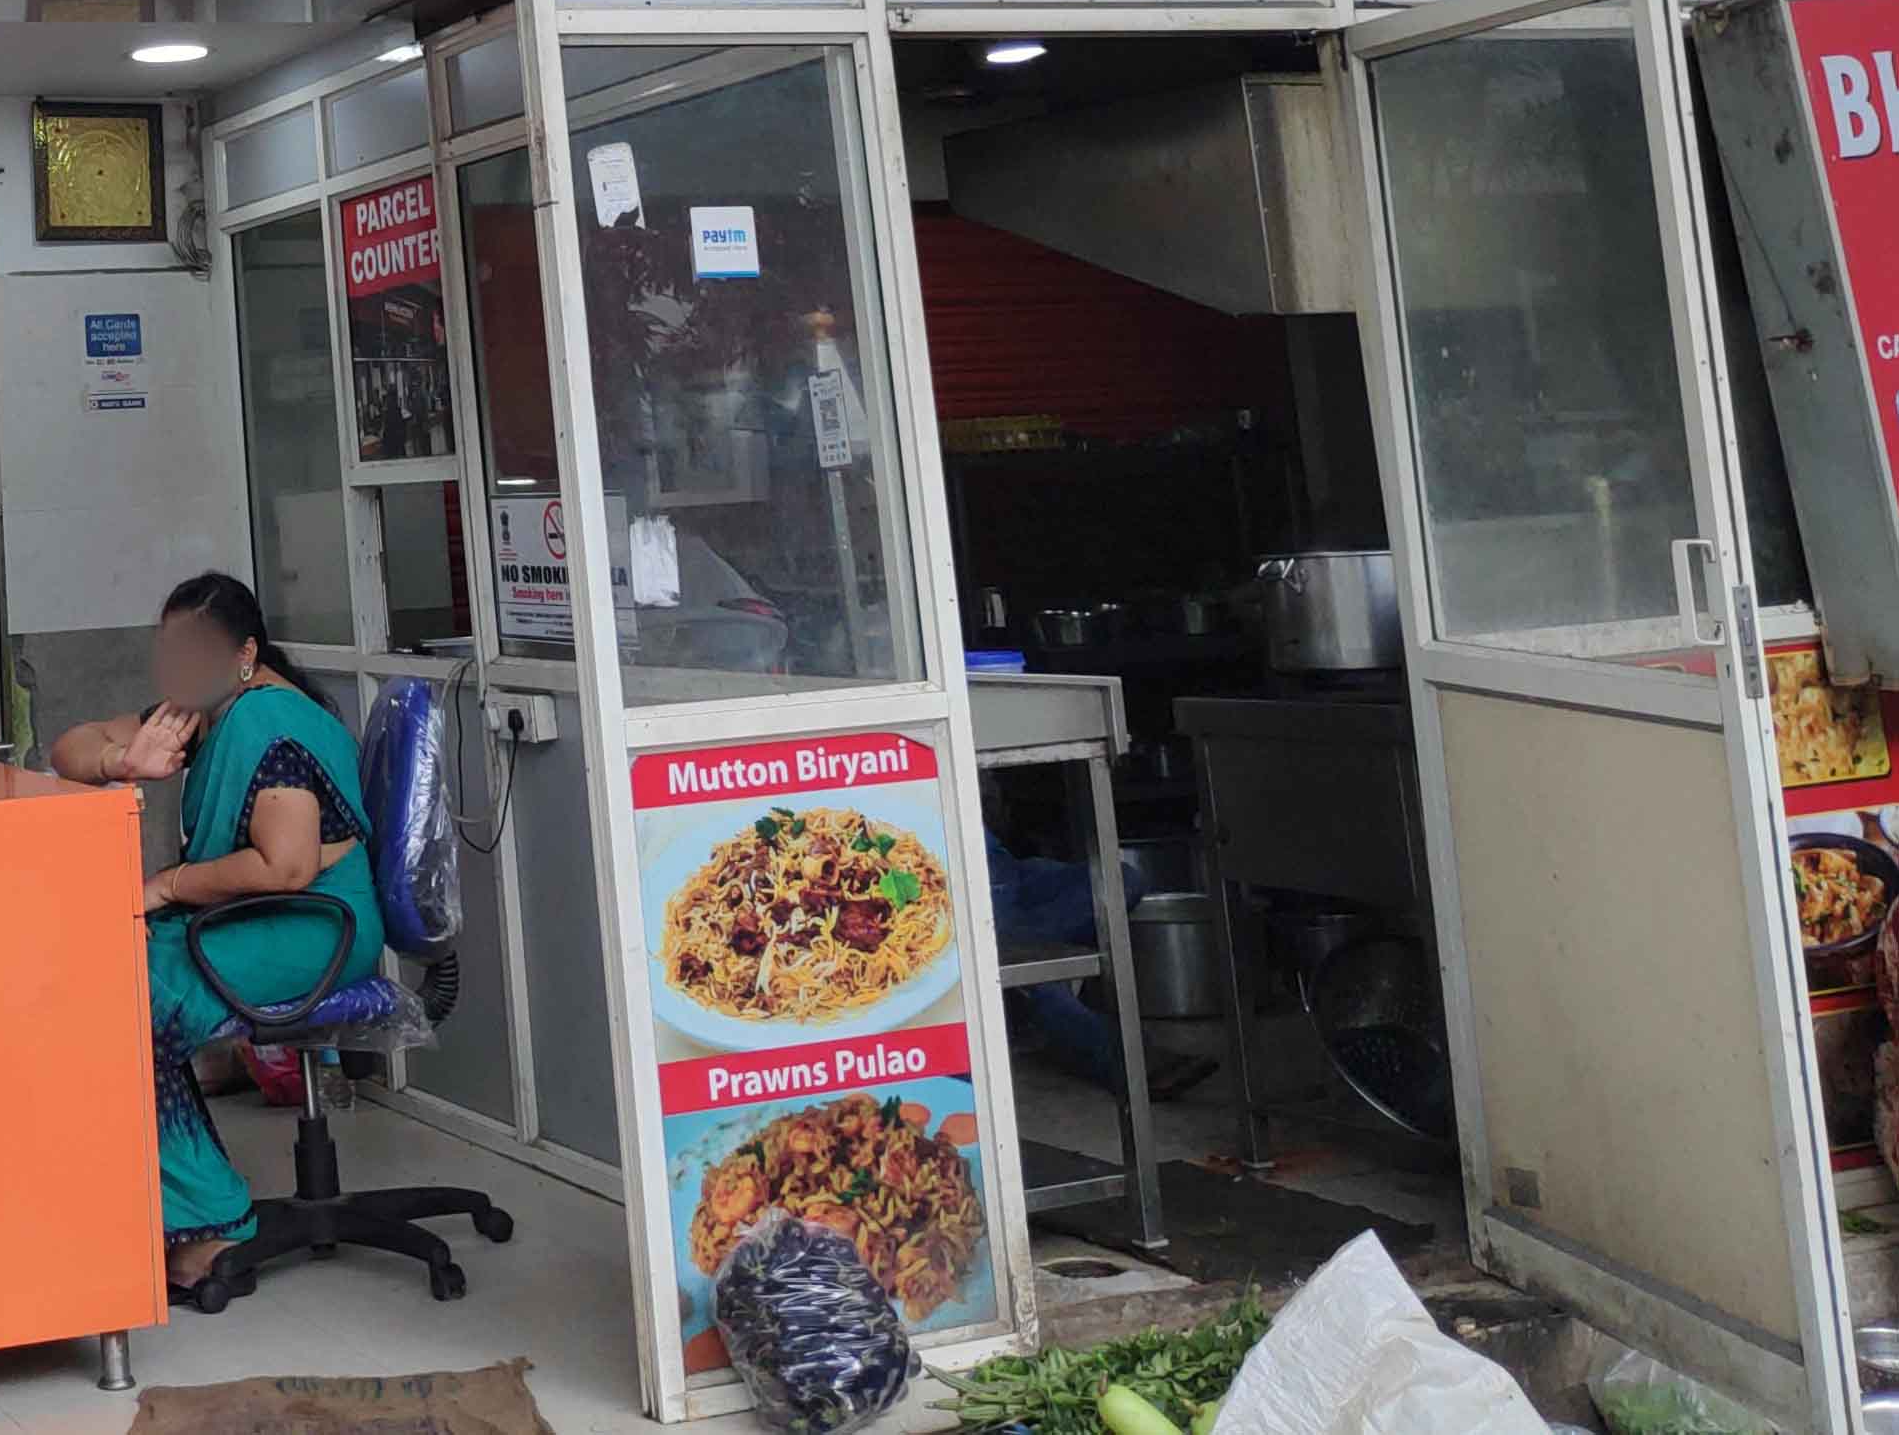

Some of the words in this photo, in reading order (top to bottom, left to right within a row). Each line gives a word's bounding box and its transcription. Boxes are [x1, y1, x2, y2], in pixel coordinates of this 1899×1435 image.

[355, 183, 432, 237] PARCEL
[500, 564, 519, 583] NO
[521, 565, 570, 585] SMOKI
[667, 750, 790, 796] Mutton
[795, 740, 910, 789] Biryani
[707, 1059, 830, 1102] Prawns
[834, 1041, 928, 1085] Pulao
